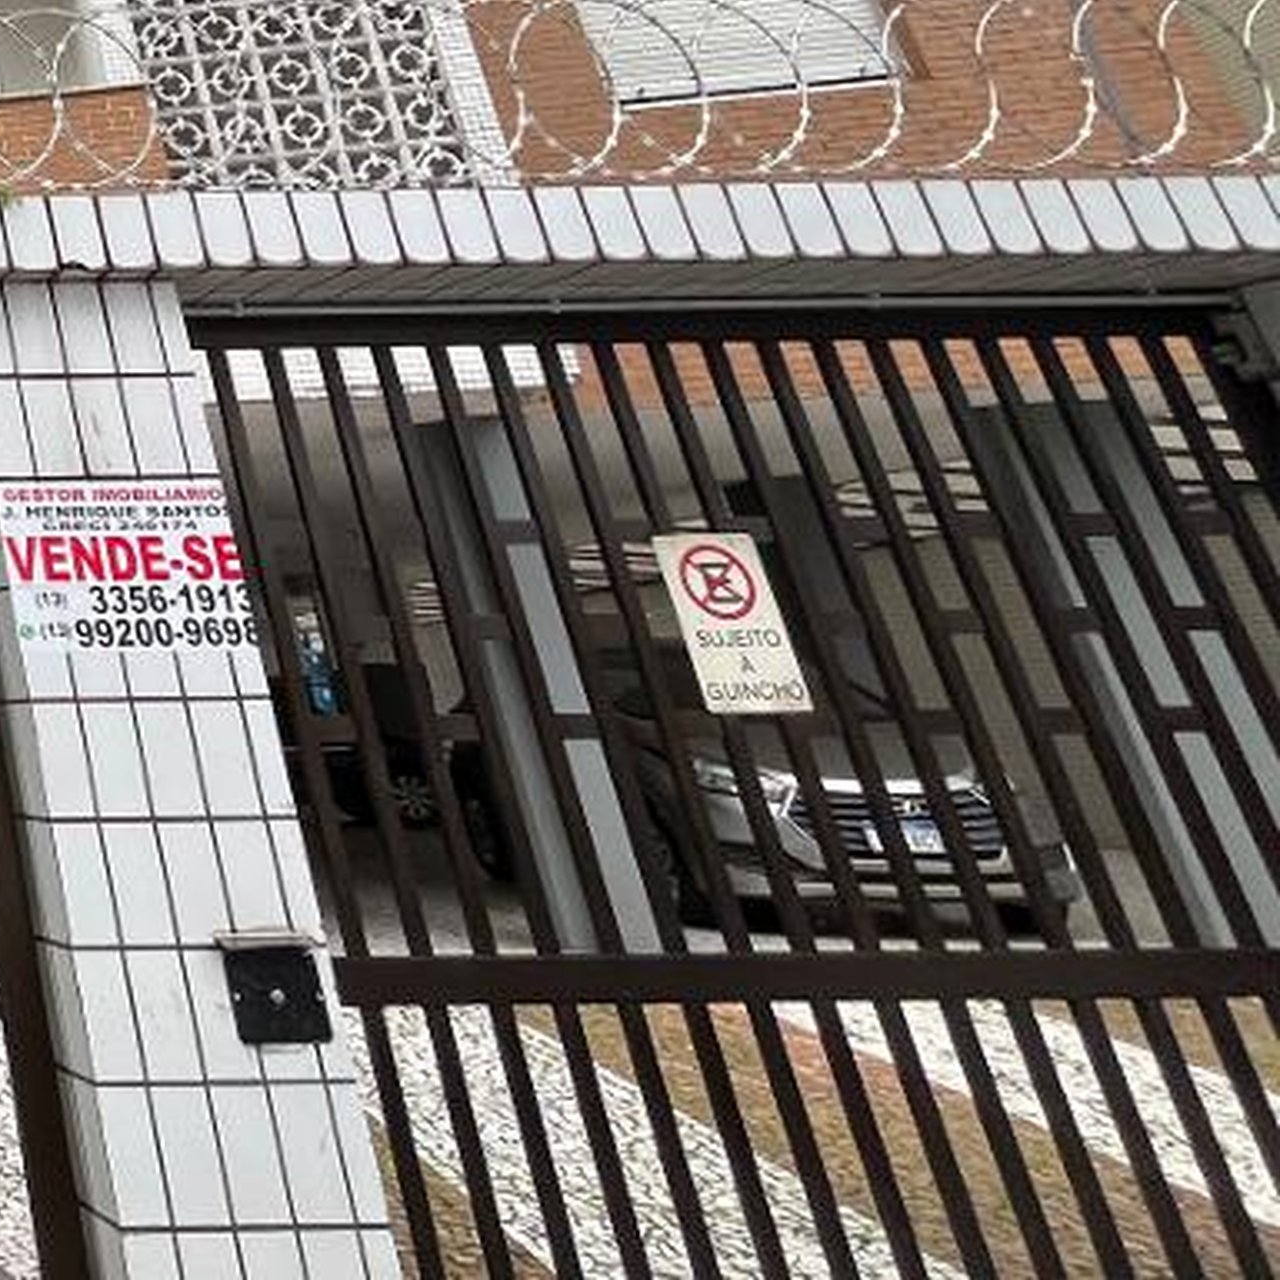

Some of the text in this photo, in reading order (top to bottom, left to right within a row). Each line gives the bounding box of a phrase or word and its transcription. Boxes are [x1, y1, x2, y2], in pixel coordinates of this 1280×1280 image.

[2, 488, 86, 502] GESTOR
[25, 505, 139, 519] HENRIQUE
[4, 535, 248, 581] VENDE-SE
[89, 585, 255, 614] 3356-1913
[75, 618, 261, 648] 99200-9698
[696, 629, 782, 647] SUJEITO
[706, 680, 805, 702] GUINCHO
